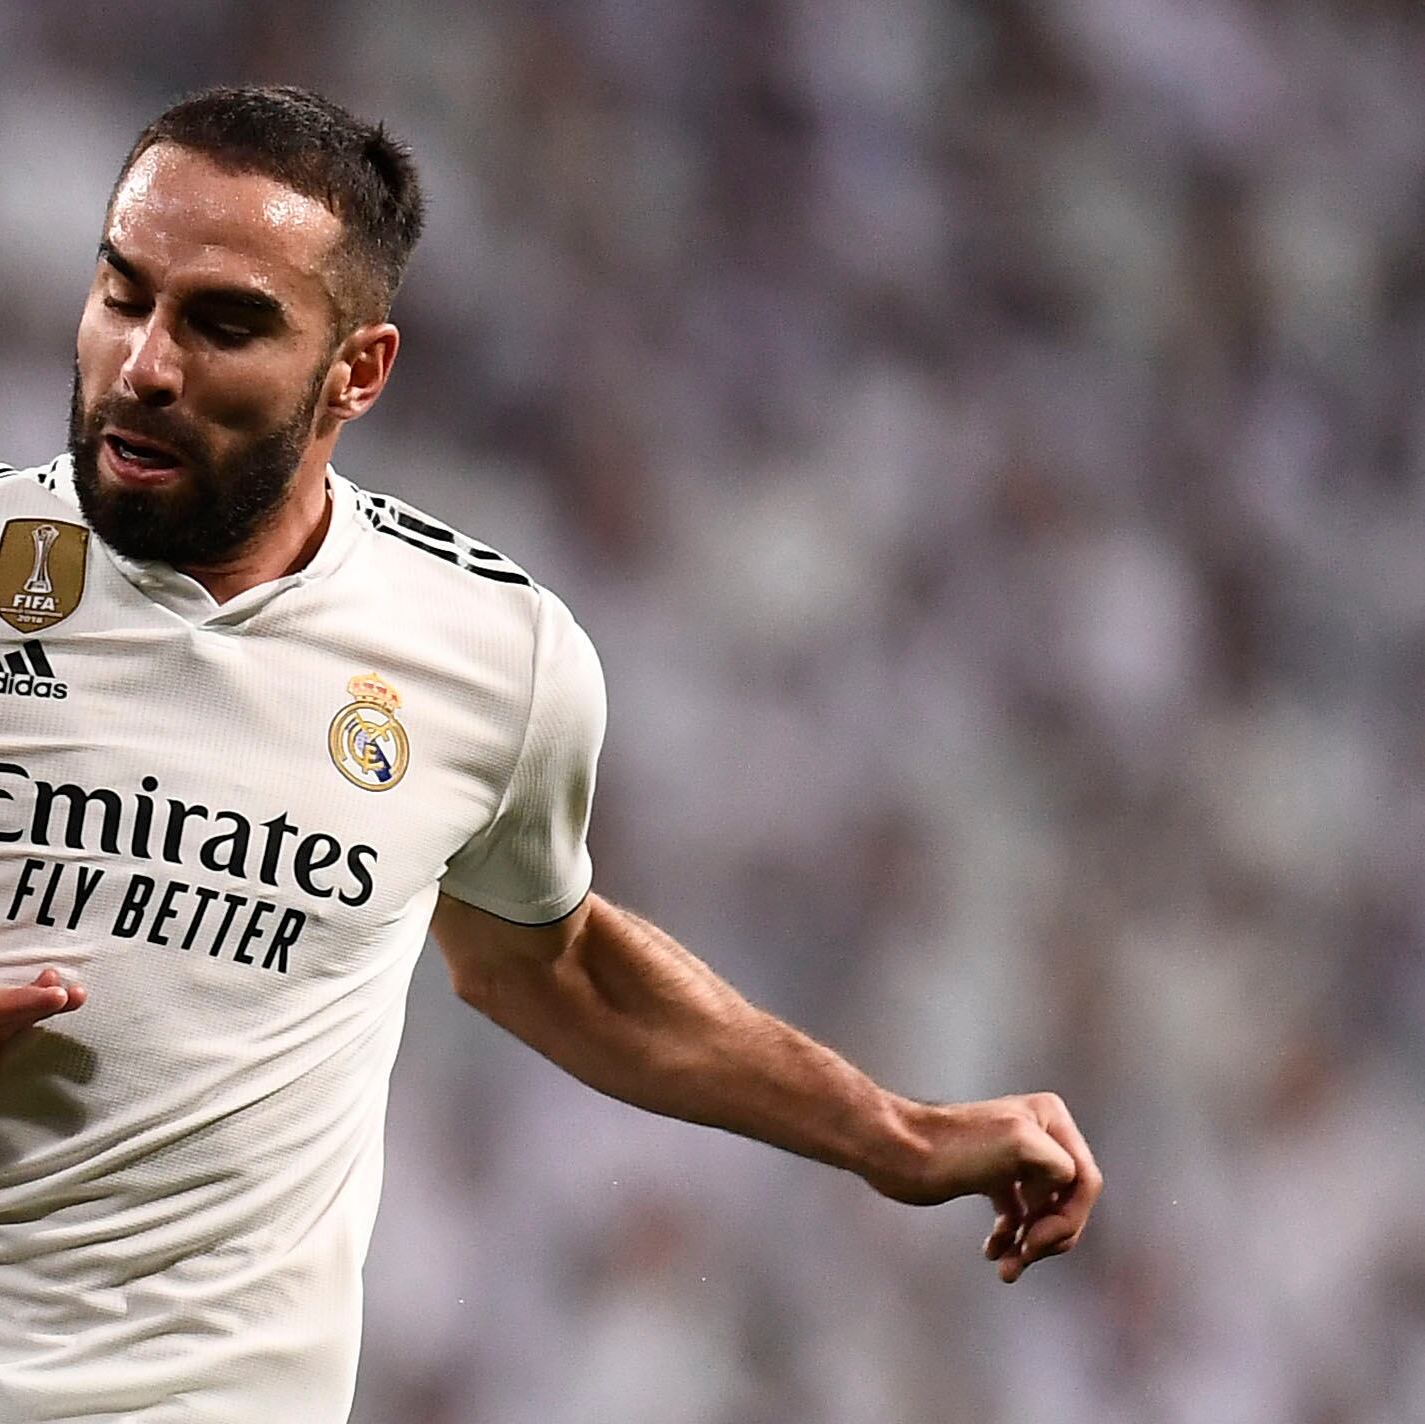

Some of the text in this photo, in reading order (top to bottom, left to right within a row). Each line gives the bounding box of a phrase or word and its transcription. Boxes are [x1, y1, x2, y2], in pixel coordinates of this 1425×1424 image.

[12, 594, 56, 611] FIFA
[6, 858, 308, 974] FLY BETTER
